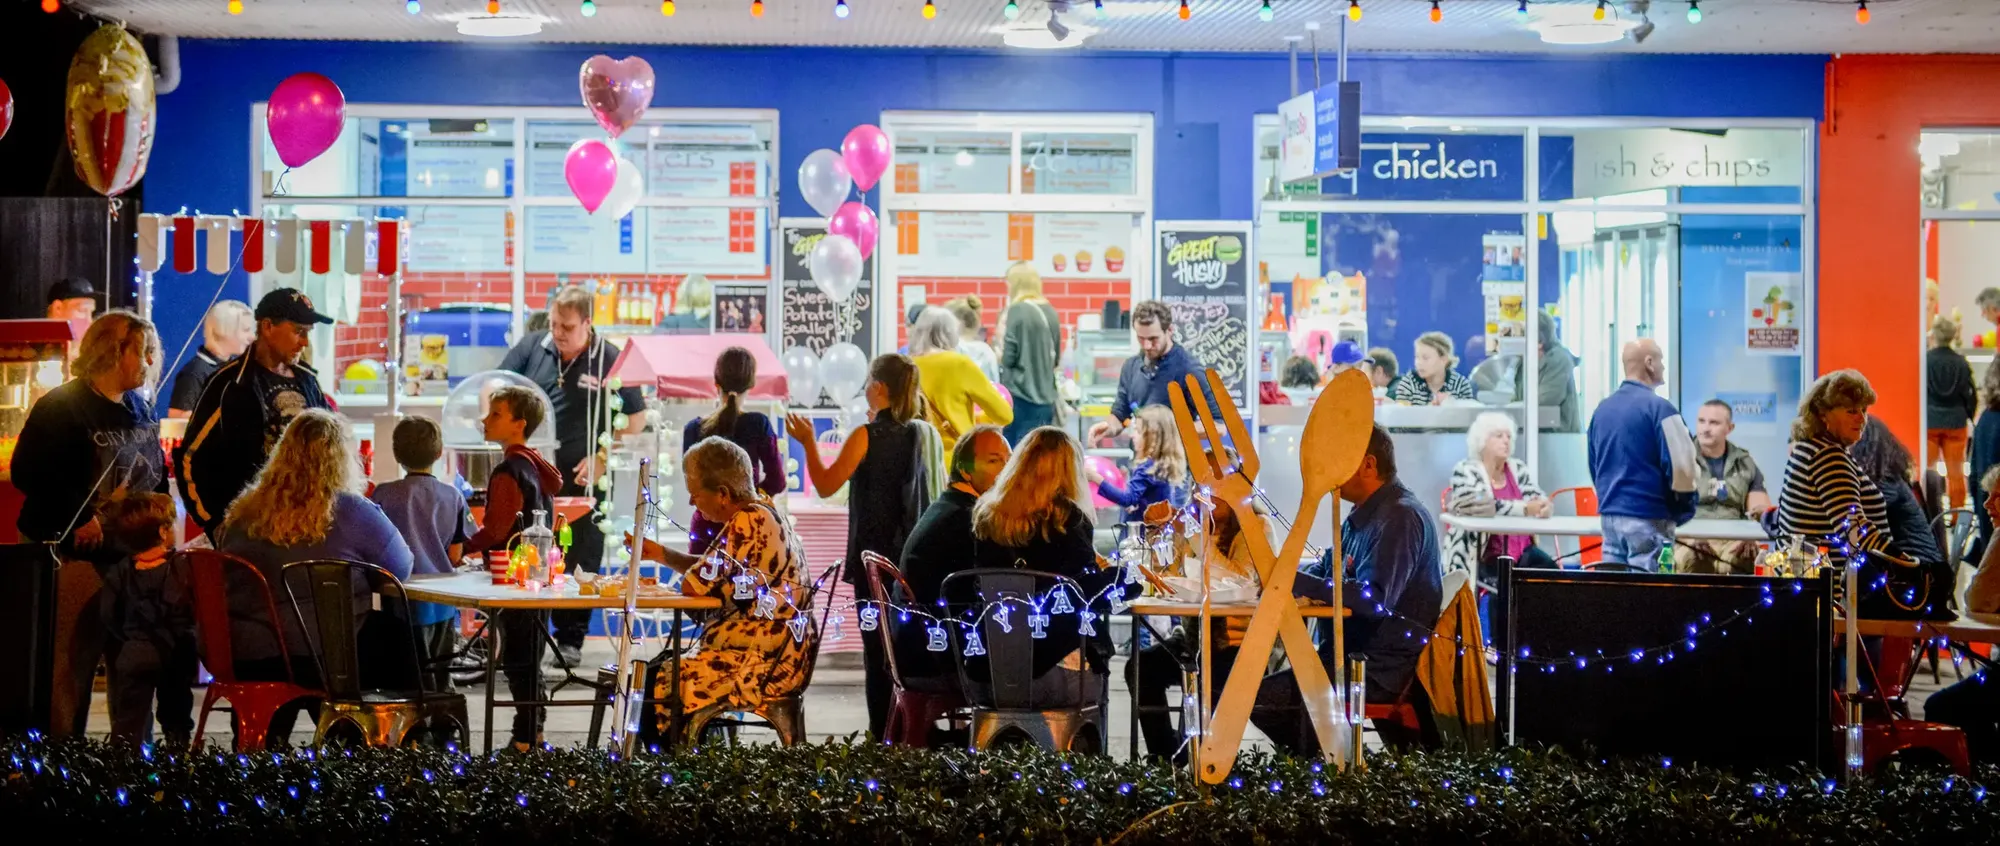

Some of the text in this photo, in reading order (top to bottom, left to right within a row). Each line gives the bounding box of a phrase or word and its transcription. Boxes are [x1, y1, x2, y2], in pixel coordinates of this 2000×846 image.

[1373, 141, 1498, 180] chicken
[1593, 144, 1637, 178] ish
[1685, 144, 1771, 187] chips
[1167, 235, 1220, 265] GREAT
[1172, 259, 1227, 290] HUSKY
[784, 305, 836, 323] Potato
[93, 428, 128, 447] CITY
